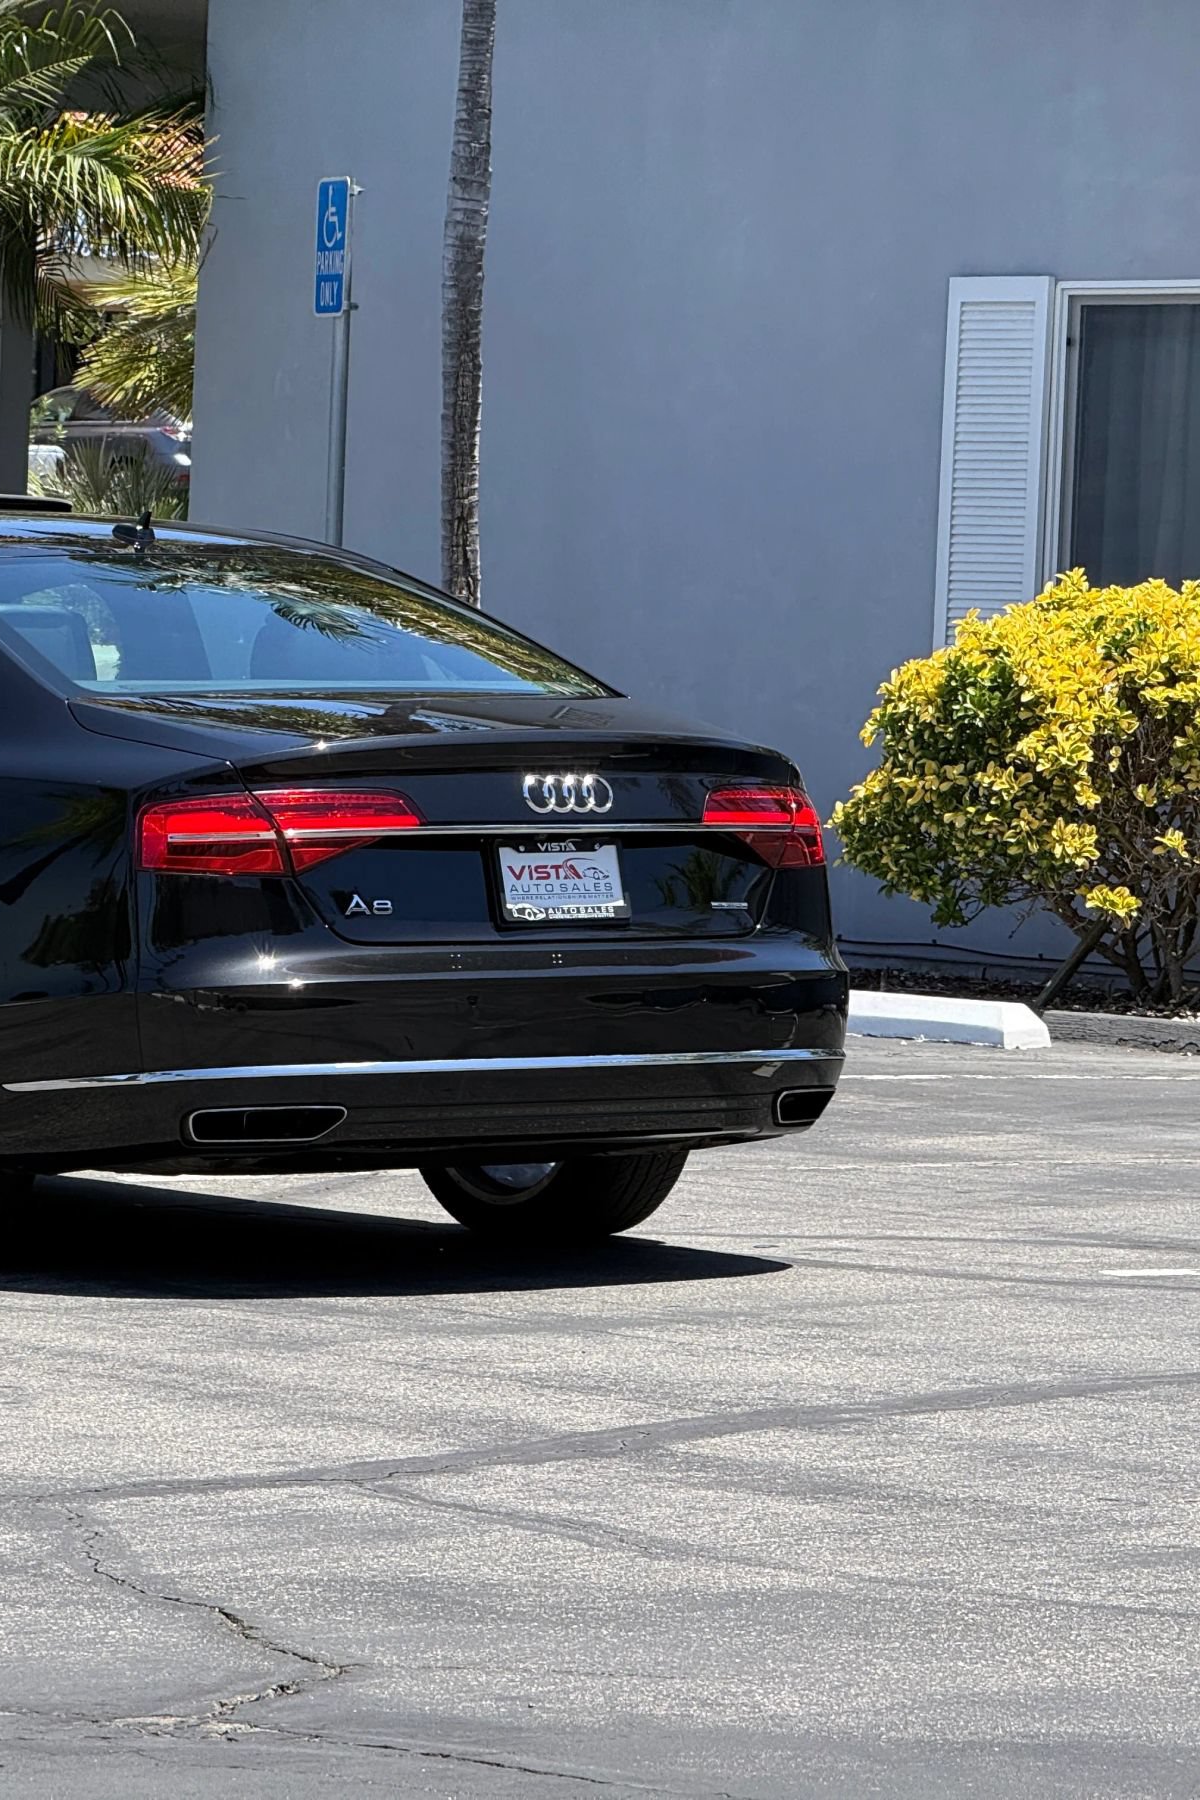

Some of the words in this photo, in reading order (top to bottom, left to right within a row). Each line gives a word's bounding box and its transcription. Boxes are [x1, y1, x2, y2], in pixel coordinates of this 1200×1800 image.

[317, 250, 344, 275] PARKING
[320, 281, 338, 306] ONLY
[537, 842, 577, 852] VISTA
[507, 863, 583, 881] VISTA
[510, 883, 554, 893] AUTO
[560, 882, 613, 893] SALES
[345, 894, 393, 915] A8
[548, 906, 577, 914] AUTO
[580, 905, 614, 914] SALES
